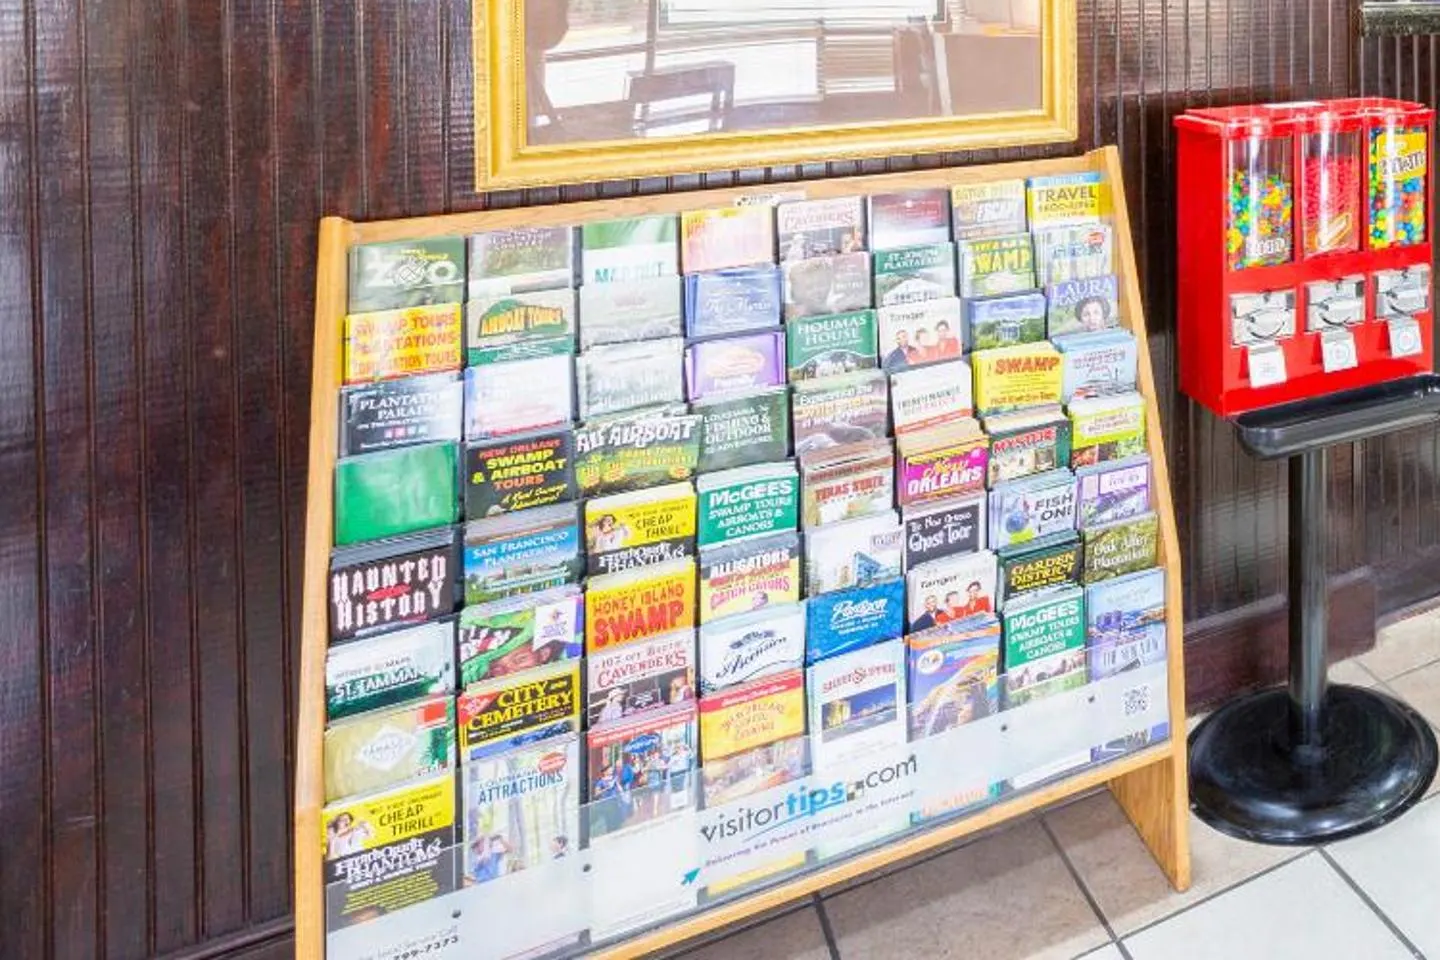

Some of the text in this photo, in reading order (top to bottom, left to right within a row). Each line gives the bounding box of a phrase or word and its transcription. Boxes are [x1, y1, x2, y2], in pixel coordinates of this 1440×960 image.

[1037, 185, 1097, 202] TRAVEL
[1052, 280, 1114, 297] LAURA
[353, 311, 458, 338] SWMP TOURS
[798, 315, 867, 336] HOUMAS
[805, 327, 859, 347] HOUSE
[995, 356, 1060, 376] SWAMP
[471, 458, 568, 484] & AIRBOAT
[486, 449, 554, 470] SWAMP
[493, 474, 545, 491] TOURS
[708, 479, 793, 508] McGEES
[907, 465, 983, 496] ORLEANS
[708, 501, 751, 520] SWAMP
[1034, 493, 1074, 512] FISH
[634, 514, 674, 530] CHEAP
[472, 530, 569, 559] SAN FRANCISCO
[908, 532, 946, 554] Ghost
[946, 521, 973, 545] Tour
[710, 548, 791, 578] ALLIGATORS
[1011, 551, 1076, 576] GARDEN
[1011, 561, 1076, 587] DISTRICT
[333, 554, 447, 604] HAUNTED
[336, 581, 444, 631] HISTORY
[593, 595, 639, 617] HONEY
[640, 583, 685, 607] ISLAND
[593, 600, 685, 646] SWAMP
[1010, 601, 1079, 632] McGEES
[354, 666, 430, 695] TAMMAN
[496, 680, 548, 708] CITY
[467, 691, 573, 730] CEMETERY
[477, 771, 565, 806] ATTRACTIONS
[378, 804, 425, 828] CHEAP
[390, 819, 435, 838] THRILL
